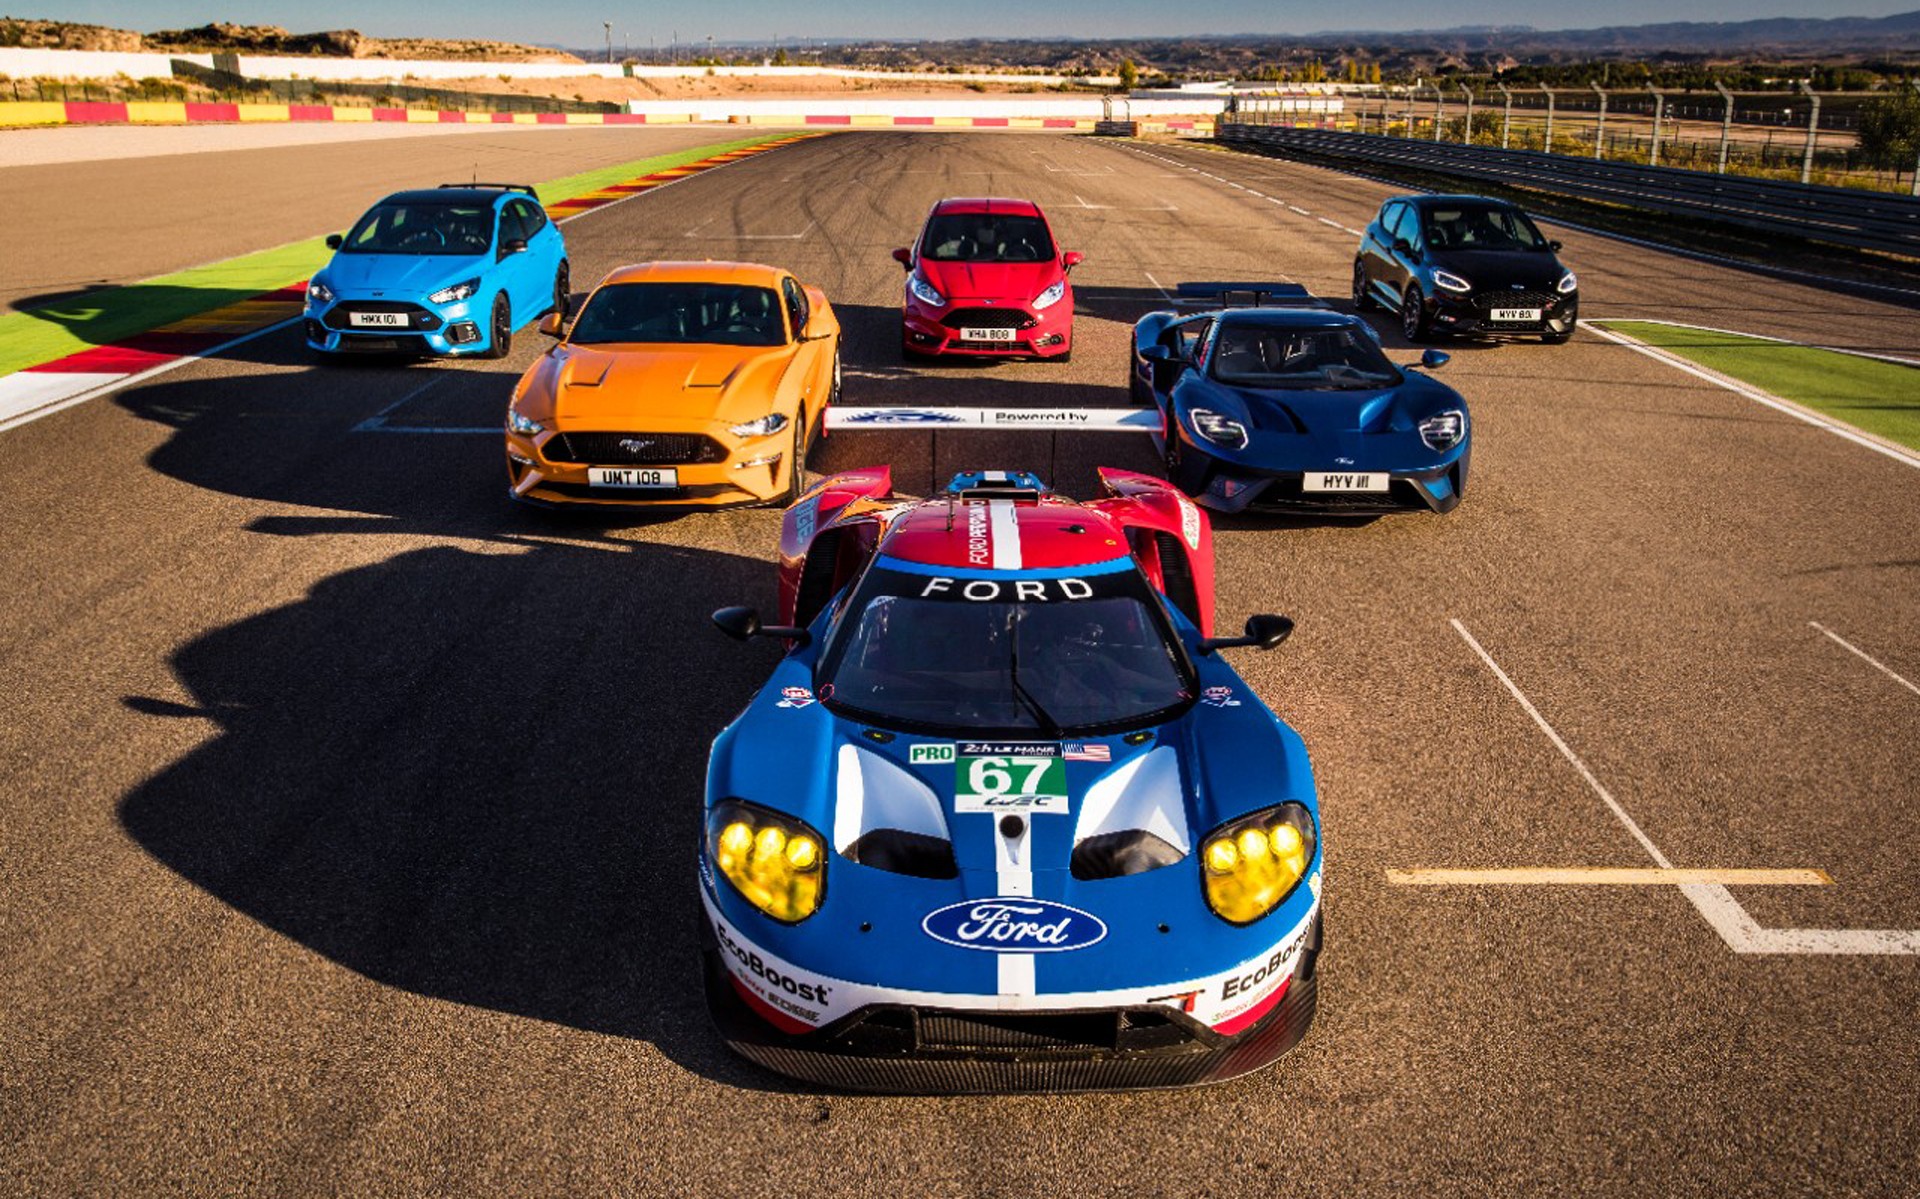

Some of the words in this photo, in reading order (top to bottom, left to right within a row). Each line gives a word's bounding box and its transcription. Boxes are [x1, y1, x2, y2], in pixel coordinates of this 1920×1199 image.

[995, 412, 1065, 421] Powered
[602, 470, 632, 485] UMT
[636, 471, 661, 485] 108
[1323, 475, 1354, 488] HYV
[920, 577, 1093, 601] FORD
[912, 747, 953, 761] PRO
[968, 757, 1053, 796] 67
[957, 904, 1072, 945] Ford
[716, 921, 830, 1007] EcoBoost
